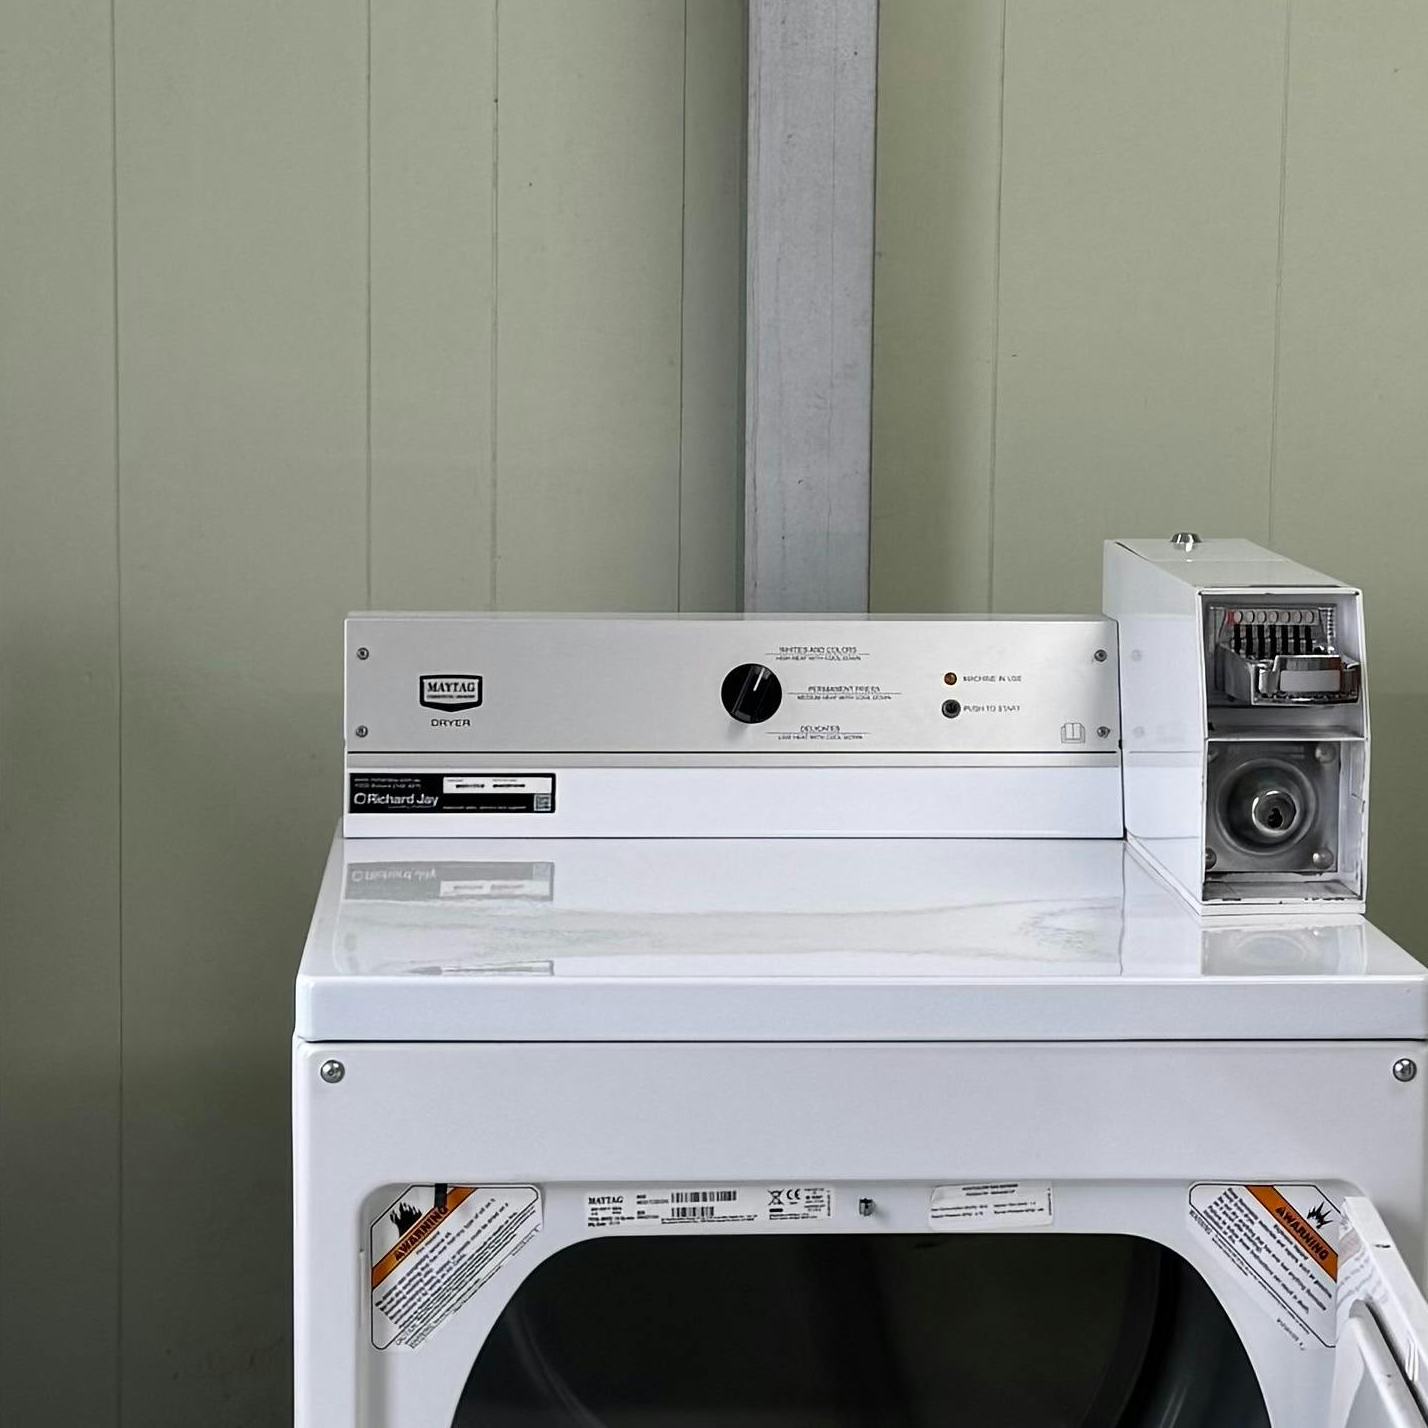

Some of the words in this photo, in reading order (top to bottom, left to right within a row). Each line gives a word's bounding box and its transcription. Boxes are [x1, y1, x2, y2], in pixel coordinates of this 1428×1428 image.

[427, 681, 476, 693] MAYTAG
[430, 718, 471, 727] DRYER
[367, 793, 415, 805] Richard
[416, 793, 439, 807] Jay
[398, 1207, 448, 1254] WARNING
[1282, 1212, 1330, 1261] WARNING
